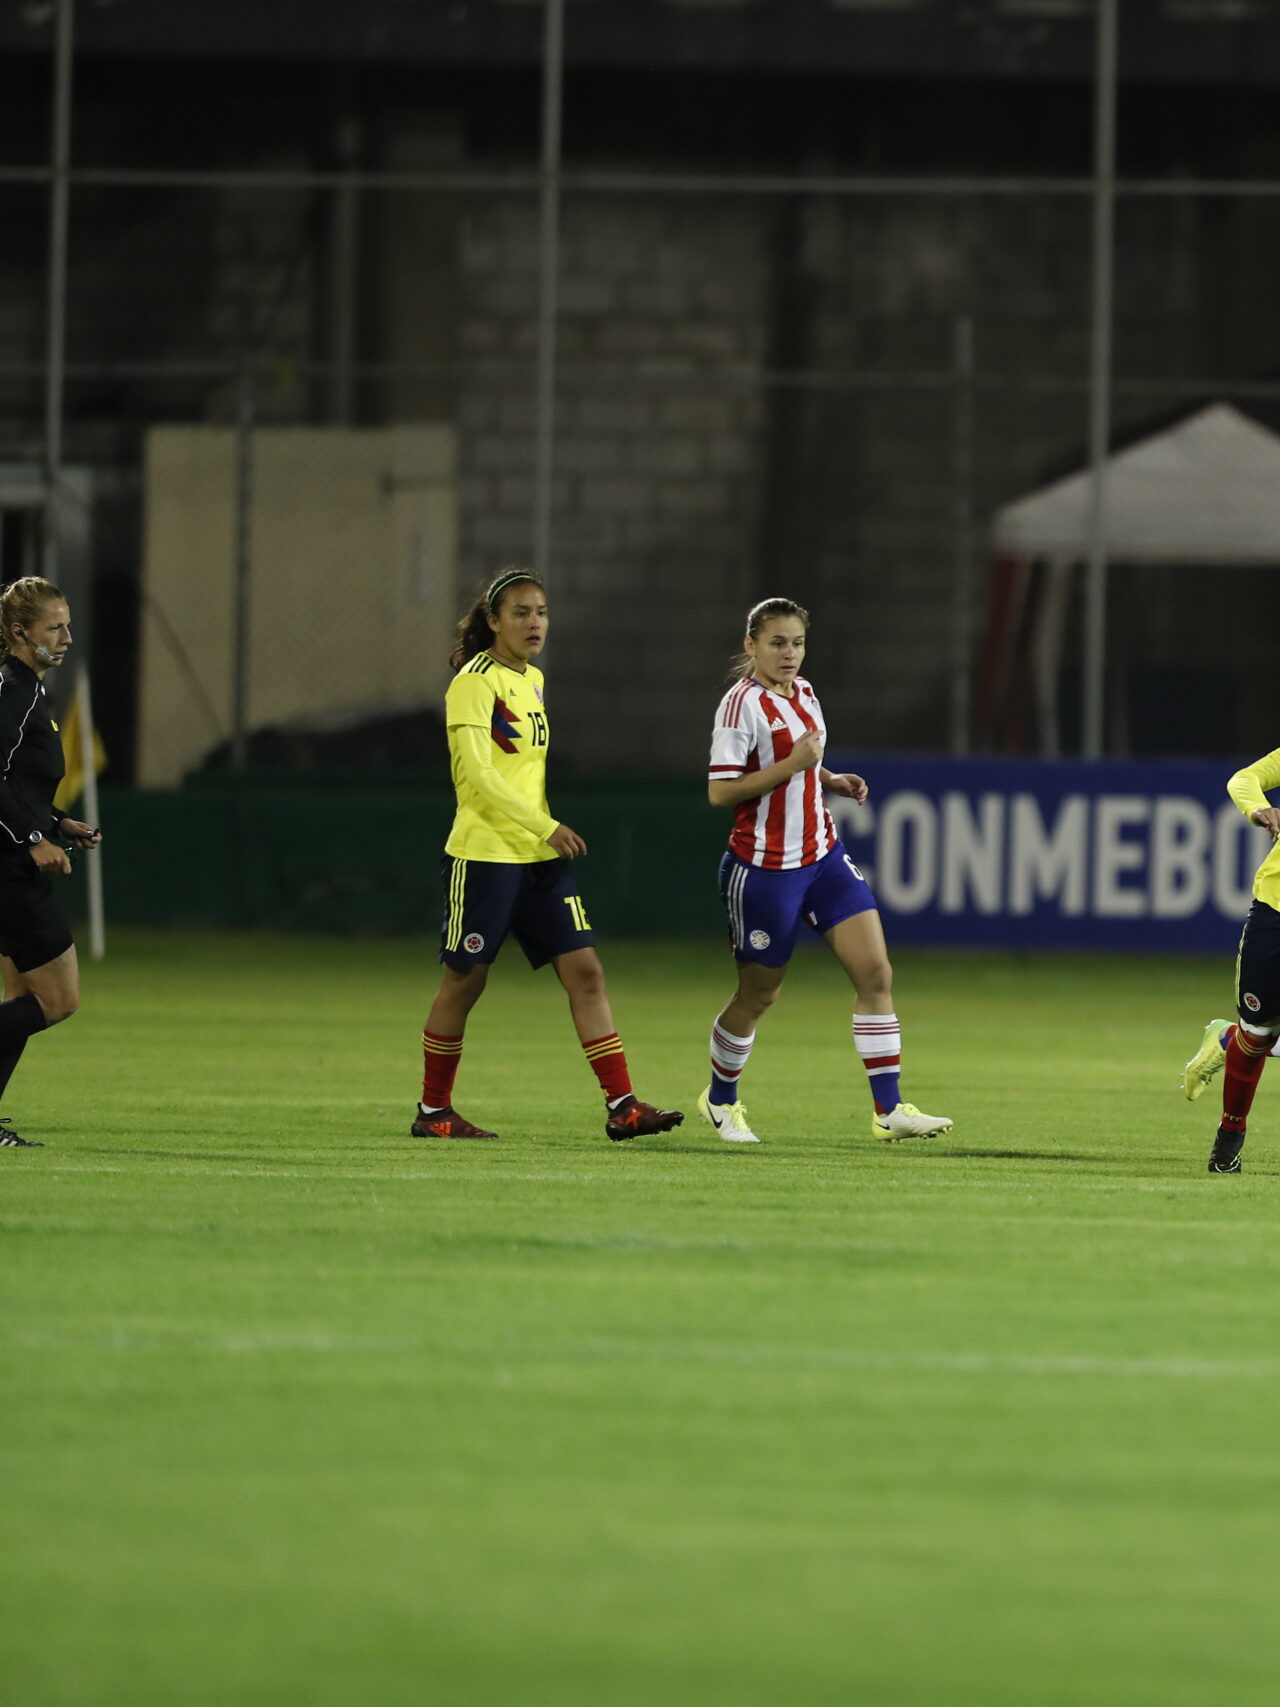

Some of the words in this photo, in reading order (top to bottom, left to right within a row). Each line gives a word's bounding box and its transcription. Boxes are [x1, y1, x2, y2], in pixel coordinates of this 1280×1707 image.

[527, 711, 547, 747] 18
[827, 790, 1274, 922] CONMEBO
[843, 853, 865, 881] 6
